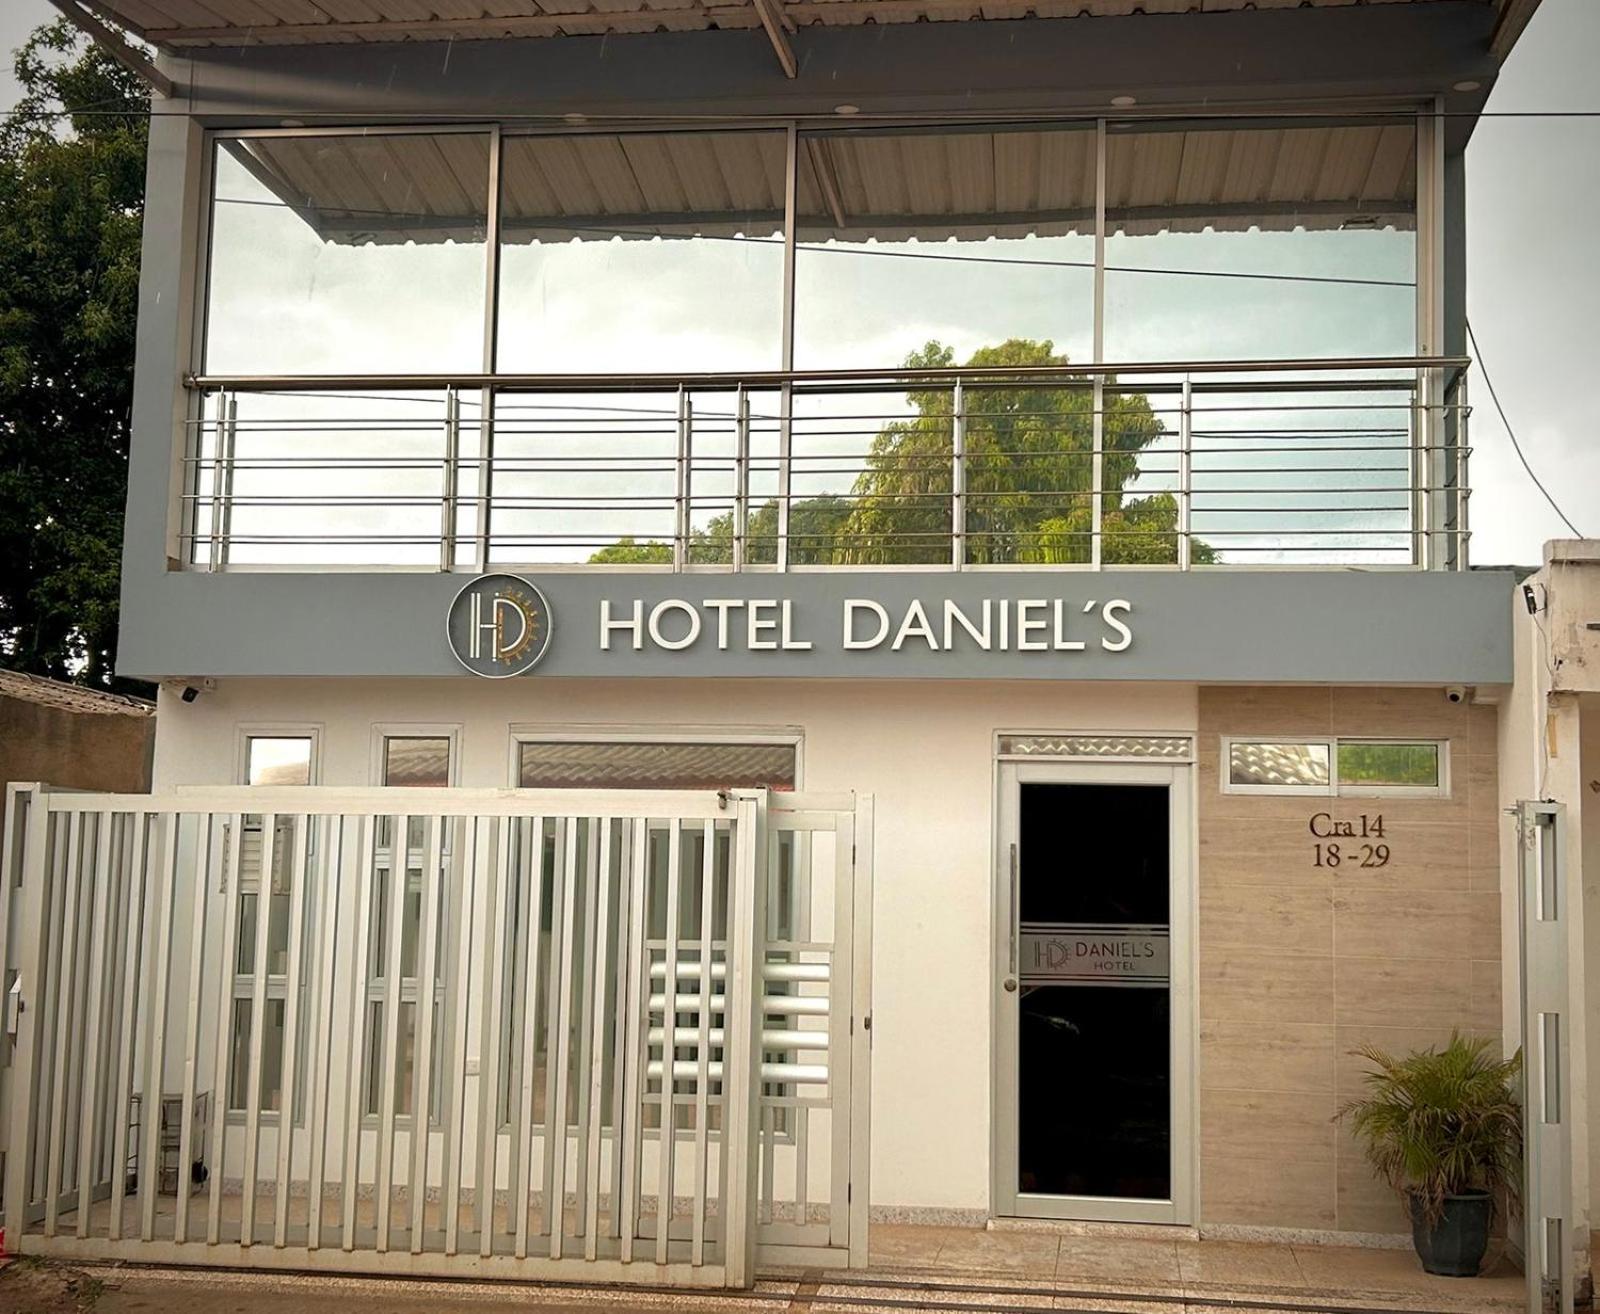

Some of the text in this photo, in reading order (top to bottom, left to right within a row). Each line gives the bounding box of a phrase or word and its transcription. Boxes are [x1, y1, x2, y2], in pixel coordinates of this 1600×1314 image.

[600, 599, 813, 651] HOTEL
[1309, 812, 1387, 839] Cra 14
[1075, 941, 1155, 958] DANIEL'S
[1093, 960, 1136, 972] HOTEL
